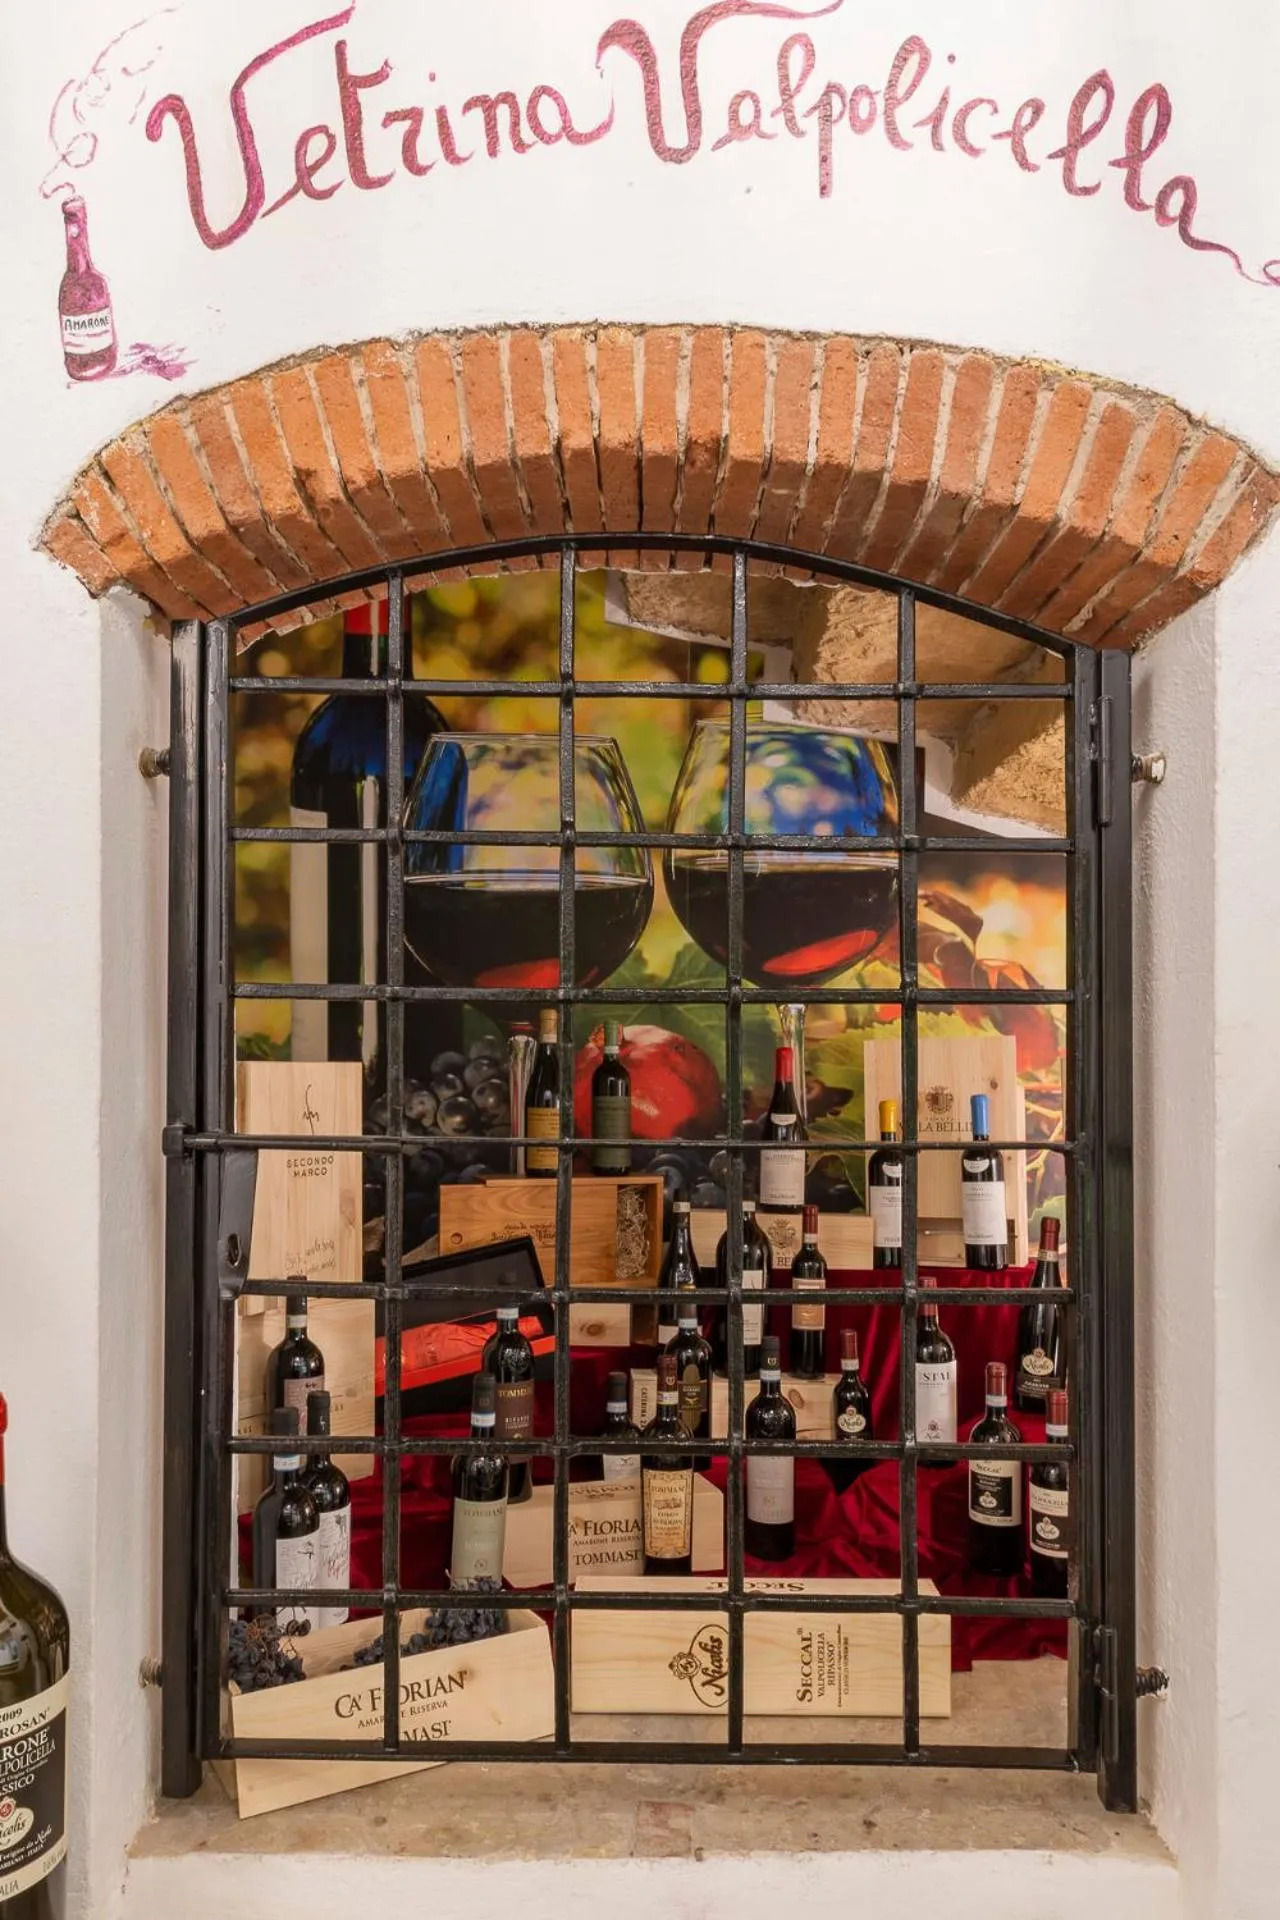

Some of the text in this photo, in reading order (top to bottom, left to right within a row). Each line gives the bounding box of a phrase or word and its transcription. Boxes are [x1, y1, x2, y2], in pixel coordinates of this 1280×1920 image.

[146, 0, 1280, 285] Vetrina Valpolicella
[64, 316, 109, 331] AMARONE
[286, 1155, 334, 1169] SECONDO
[293, 1167, 328, 1178] MARCO
[583, 1518, 642, 1537] FLORIA
[573, 1548, 640, 1566] TOMMASI
[710, 1581, 805, 1592] SECCL
[796, 1632, 813, 1703] SECCAL
[817, 1632, 825, 1698] VALPOLICELLA
[827, 1642, 836, 1686] RIPASSO
[368, 1671, 466, 1712] FORIAN
[0, 1707, 23, 1724] 009
[410, 1700, 448, 1716] RISERVA
[0, 1711, 47, 1739] ROSAN
[0, 1727, 49, 1762] RONE
[1, 1773, 35, 1793] SSICO
[0, 1879, 20, 1896] ALIA
